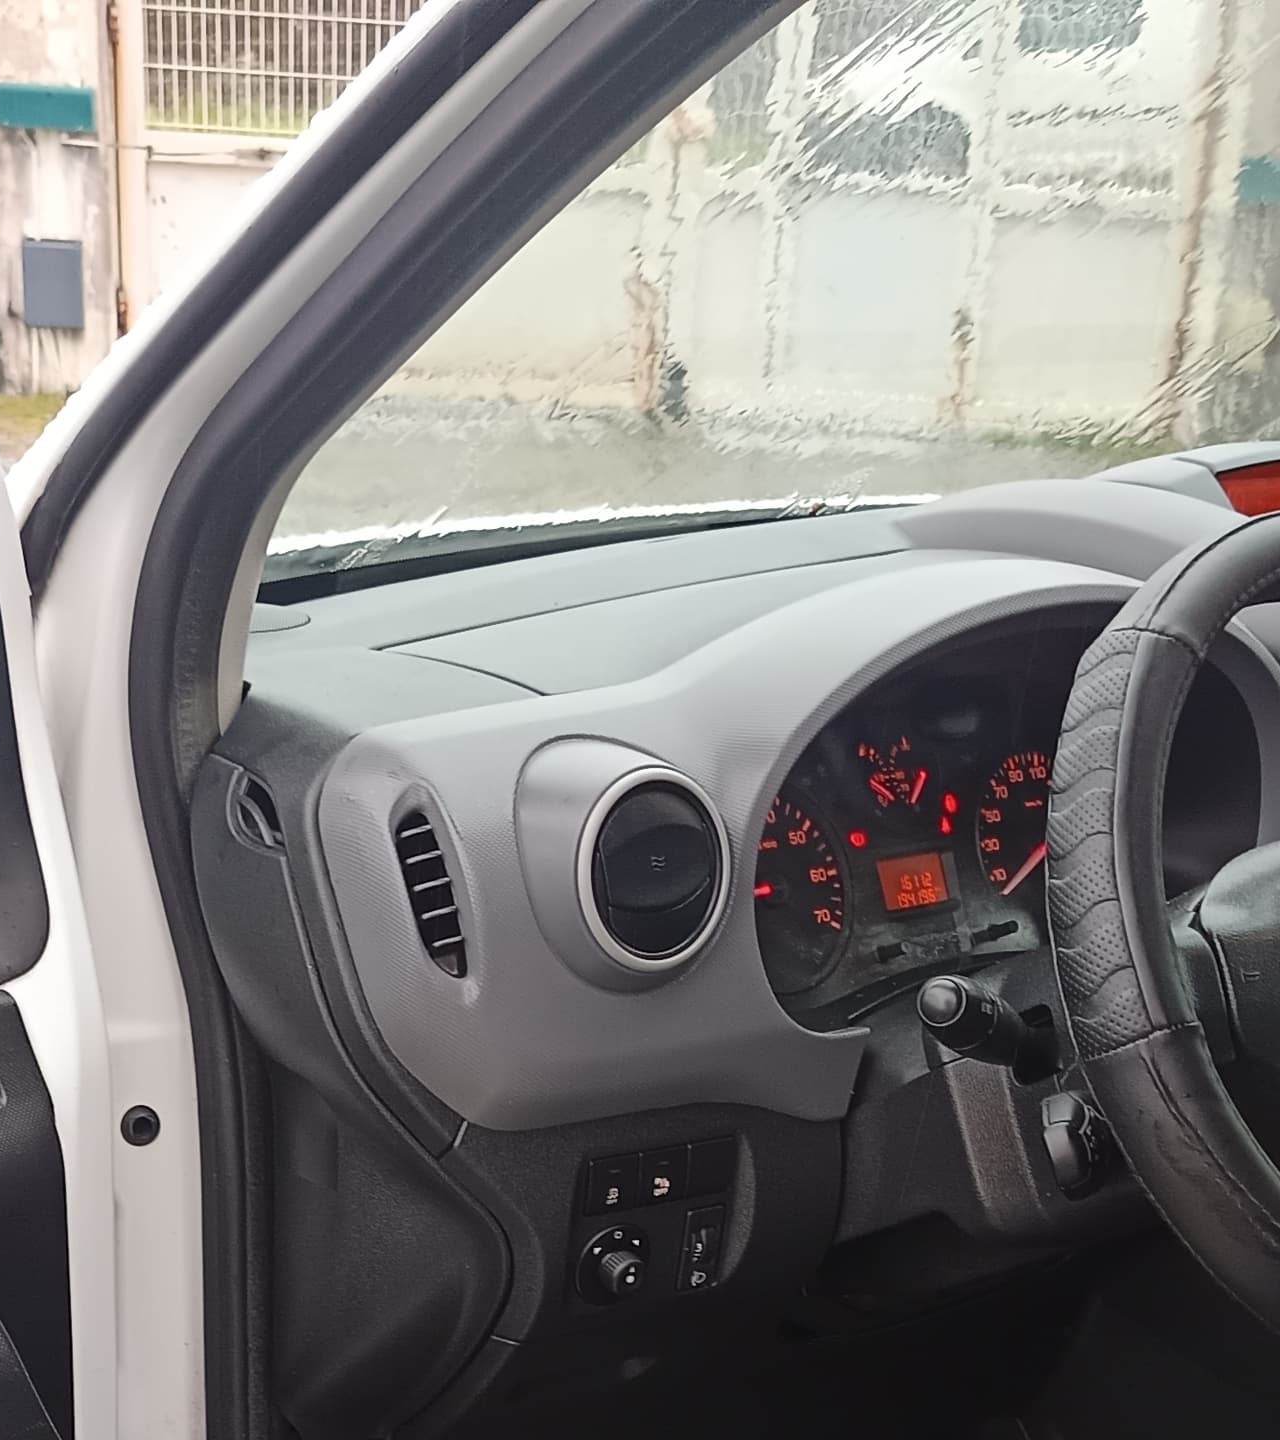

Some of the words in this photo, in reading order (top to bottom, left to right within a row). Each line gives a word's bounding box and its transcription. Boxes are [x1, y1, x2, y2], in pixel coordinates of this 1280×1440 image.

[1008, 769, 1023, 783] 90
[1029, 766, 1046, 780] 110
[993, 785, 1008, 799] 70
[985, 809, 1001, 823] 50
[788, 830, 806, 845] 50
[984, 838, 1000, 852] 30
[809, 868, 827, 882] 60
[814, 908, 831, 923] 70
